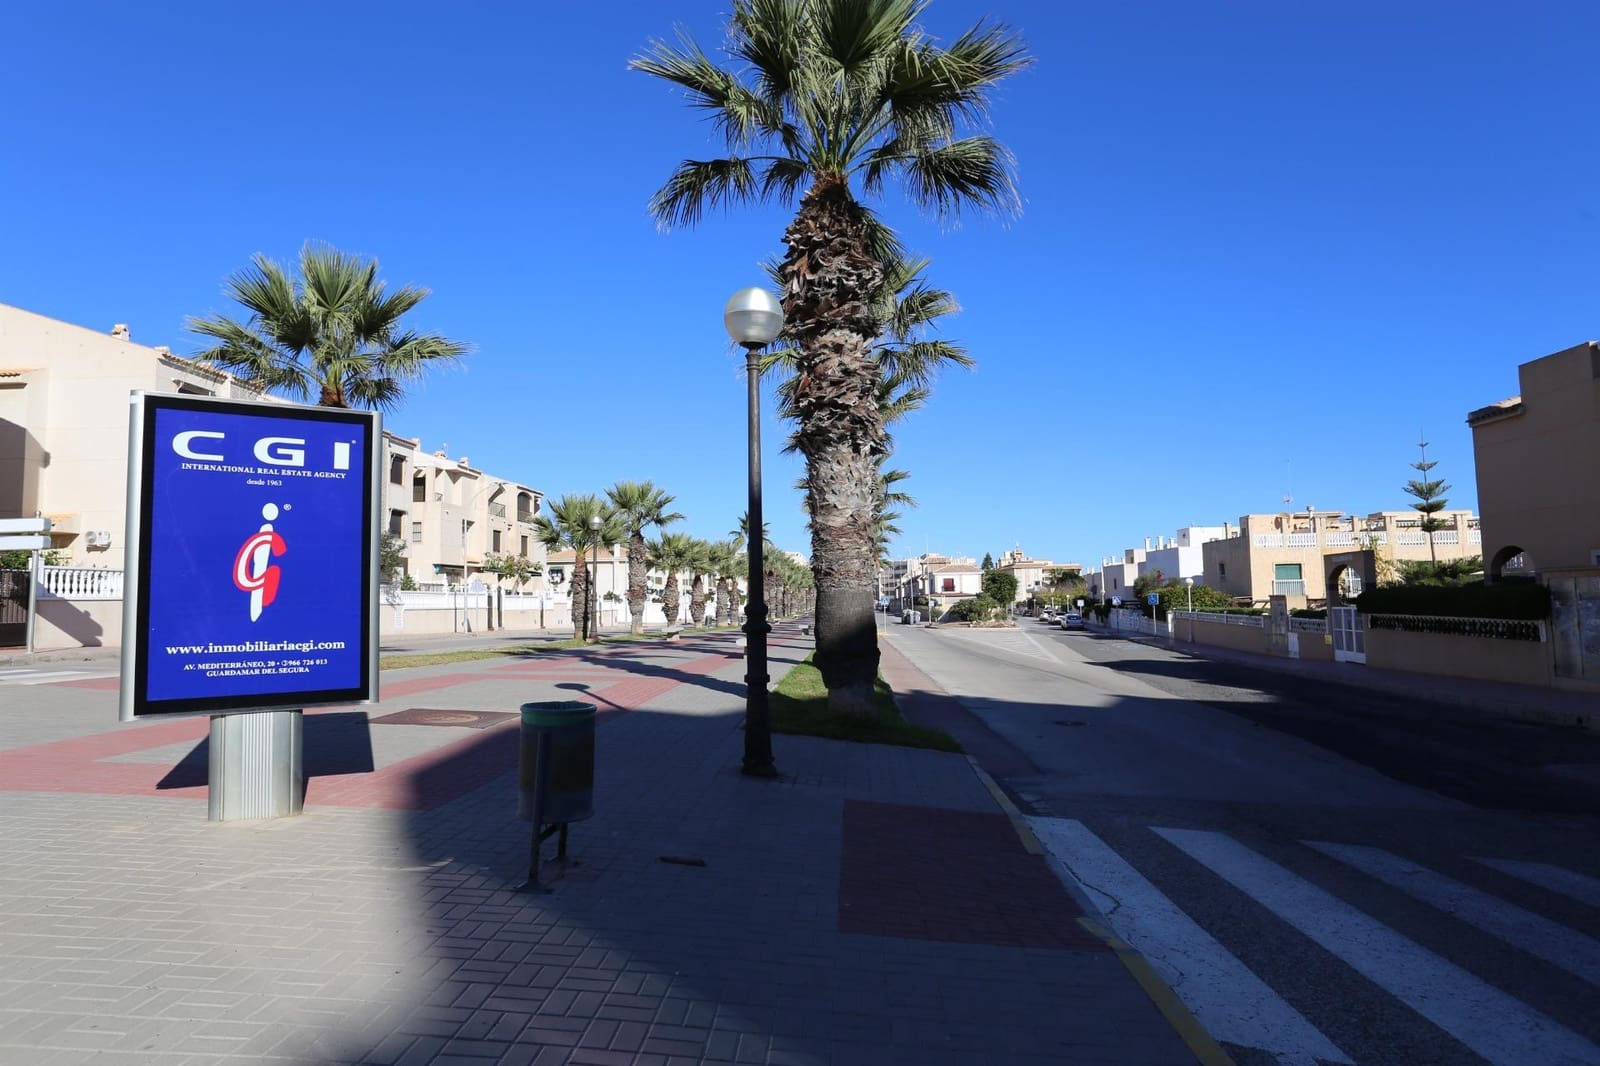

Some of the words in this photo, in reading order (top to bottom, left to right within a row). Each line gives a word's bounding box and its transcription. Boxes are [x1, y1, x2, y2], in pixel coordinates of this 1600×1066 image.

[181, 462, 255, 474] INTERNATIONAL
[257, 467, 279, 476] REAL
[281, 469, 312, 477] ESTATE
[313, 471, 346, 479] AGENCY
[246, 478, 265, 486] desde
[266, 479, 282, 487] 1963
[166, 640, 345, 655] www.inmobiliariacgi.com
[197, 660, 266, 670] MEDITERRÁNEO,
[206, 669, 260, 678] GUARDAMAR
[261, 667, 277, 675] DEL
[278, 666, 310, 674] SEGURA
